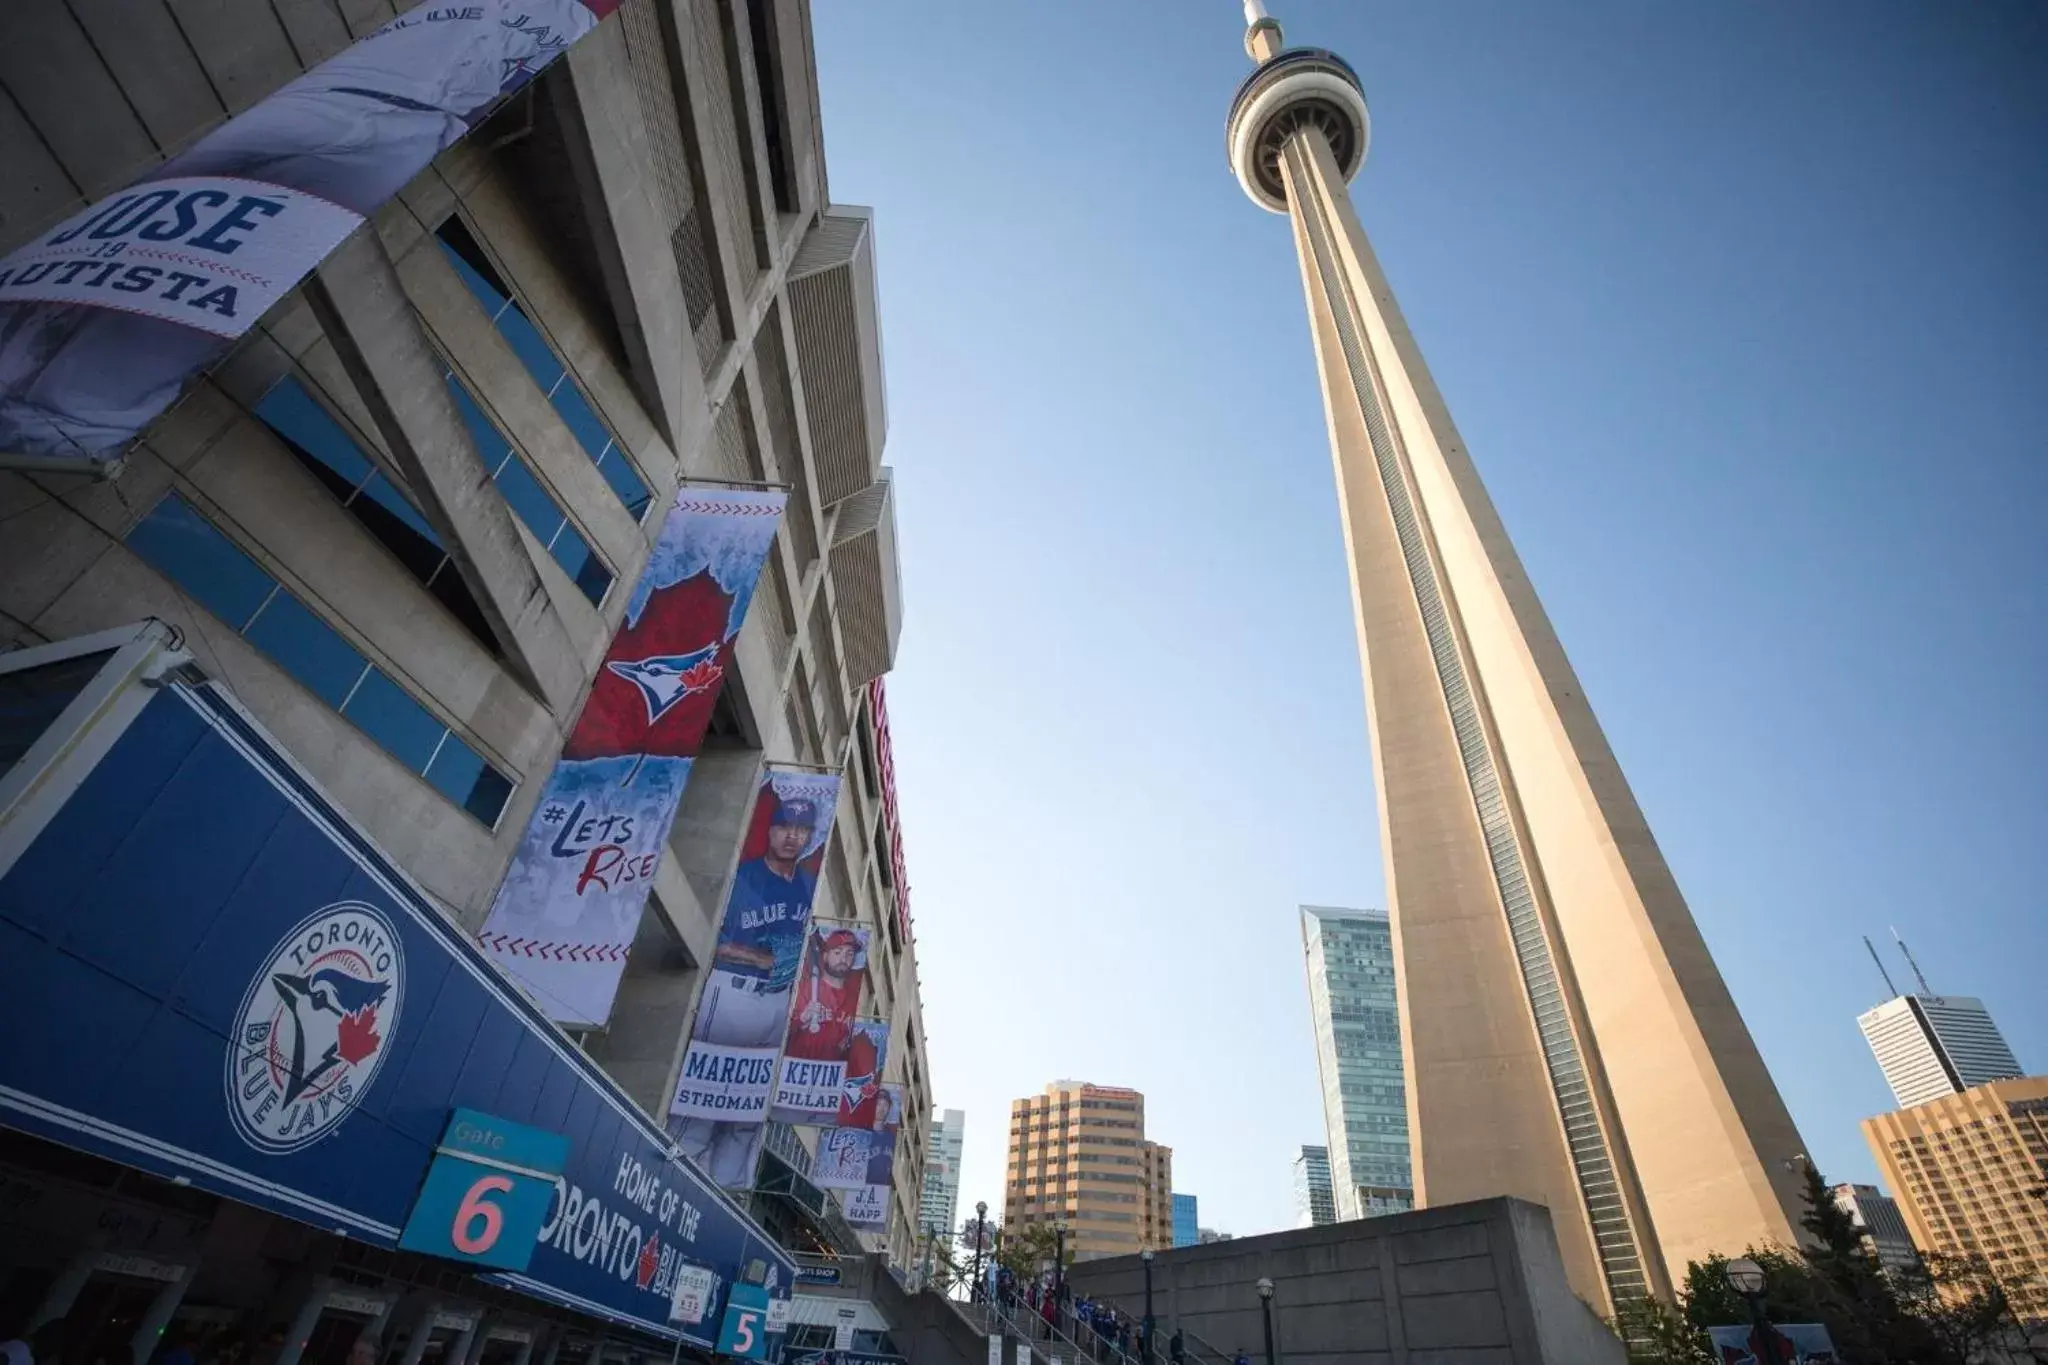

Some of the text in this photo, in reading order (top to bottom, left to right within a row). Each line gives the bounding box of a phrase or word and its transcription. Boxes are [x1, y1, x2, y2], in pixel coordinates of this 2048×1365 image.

[0, 262, 238, 318] AUTISTA
[741, 902, 787, 929] BLUE
[291, 921, 392, 973] TORONTO
[240, 1021, 280, 1125] BLUE
[685, 1052, 774, 1085] MARCUS
[784, 1061, 841, 1088] KEVIN
[277, 1075, 353, 1136] JAYS
[678, 1090, 766, 1110] STROMAN
[777, 1091, 839, 1109] PILLAR
[451, 1176, 514, 1254] 6
[614, 1152, 701, 1242] HOME OF THE
[849, 1207, 881, 1220] HAPP
[733, 1313, 758, 1353] 5
